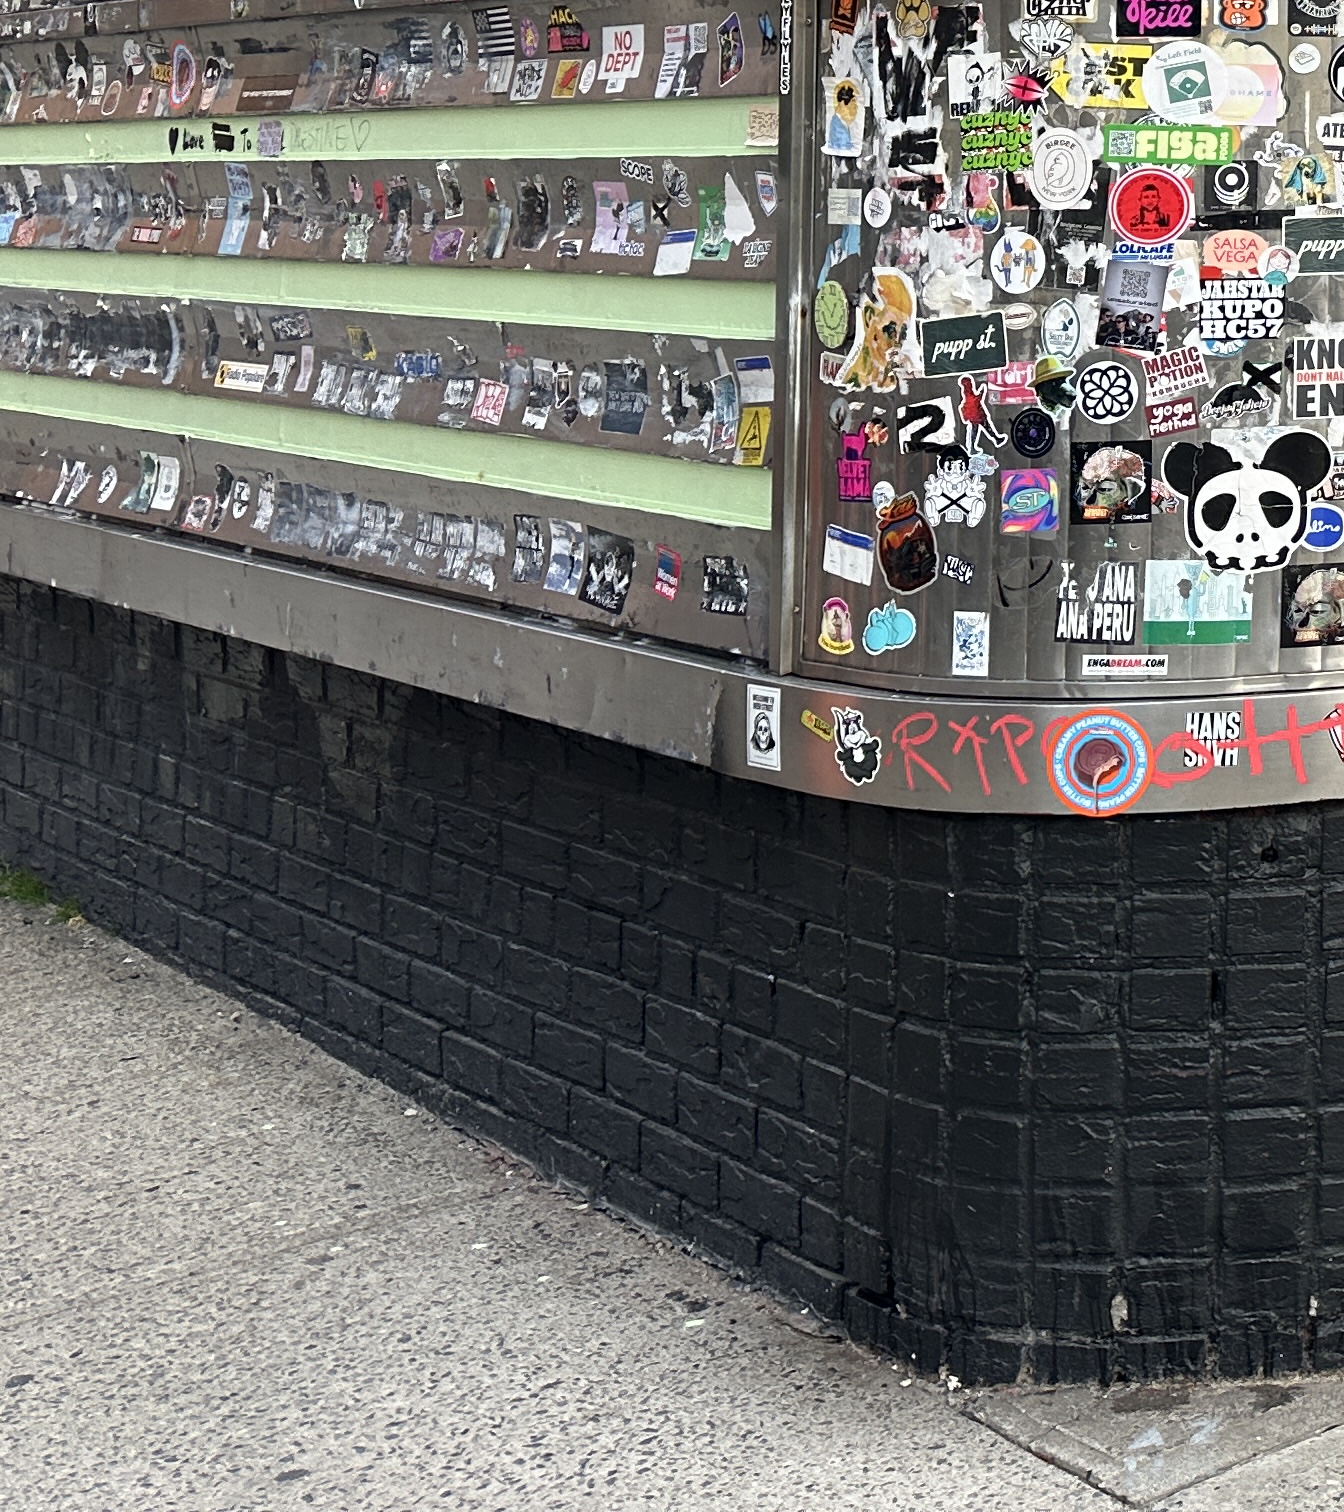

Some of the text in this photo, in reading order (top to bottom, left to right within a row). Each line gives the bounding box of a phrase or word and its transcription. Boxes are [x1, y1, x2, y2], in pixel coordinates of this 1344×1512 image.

[614, 31, 633, 51] NO
[604, 52, 640, 73] DEPT
[1213, 237, 1260, 250] SALSA
[1213, 250, 1258, 263] VEGA
[1201, 299, 1284, 319] KUPO
[1201, 319, 1285, 338] HC57
[931, 338, 973, 363] pupp
[1143, 346, 1201, 376] MAGIC
[1150, 361, 1204, 389] POTION
[1296, 372, 1324, 382] DONT
[1151, 400, 1193, 423] yoga
[1103, 564, 1136, 602] ANA
[1091, 602, 1135, 642] PERU
[1186, 711, 1241, 740] HANS
